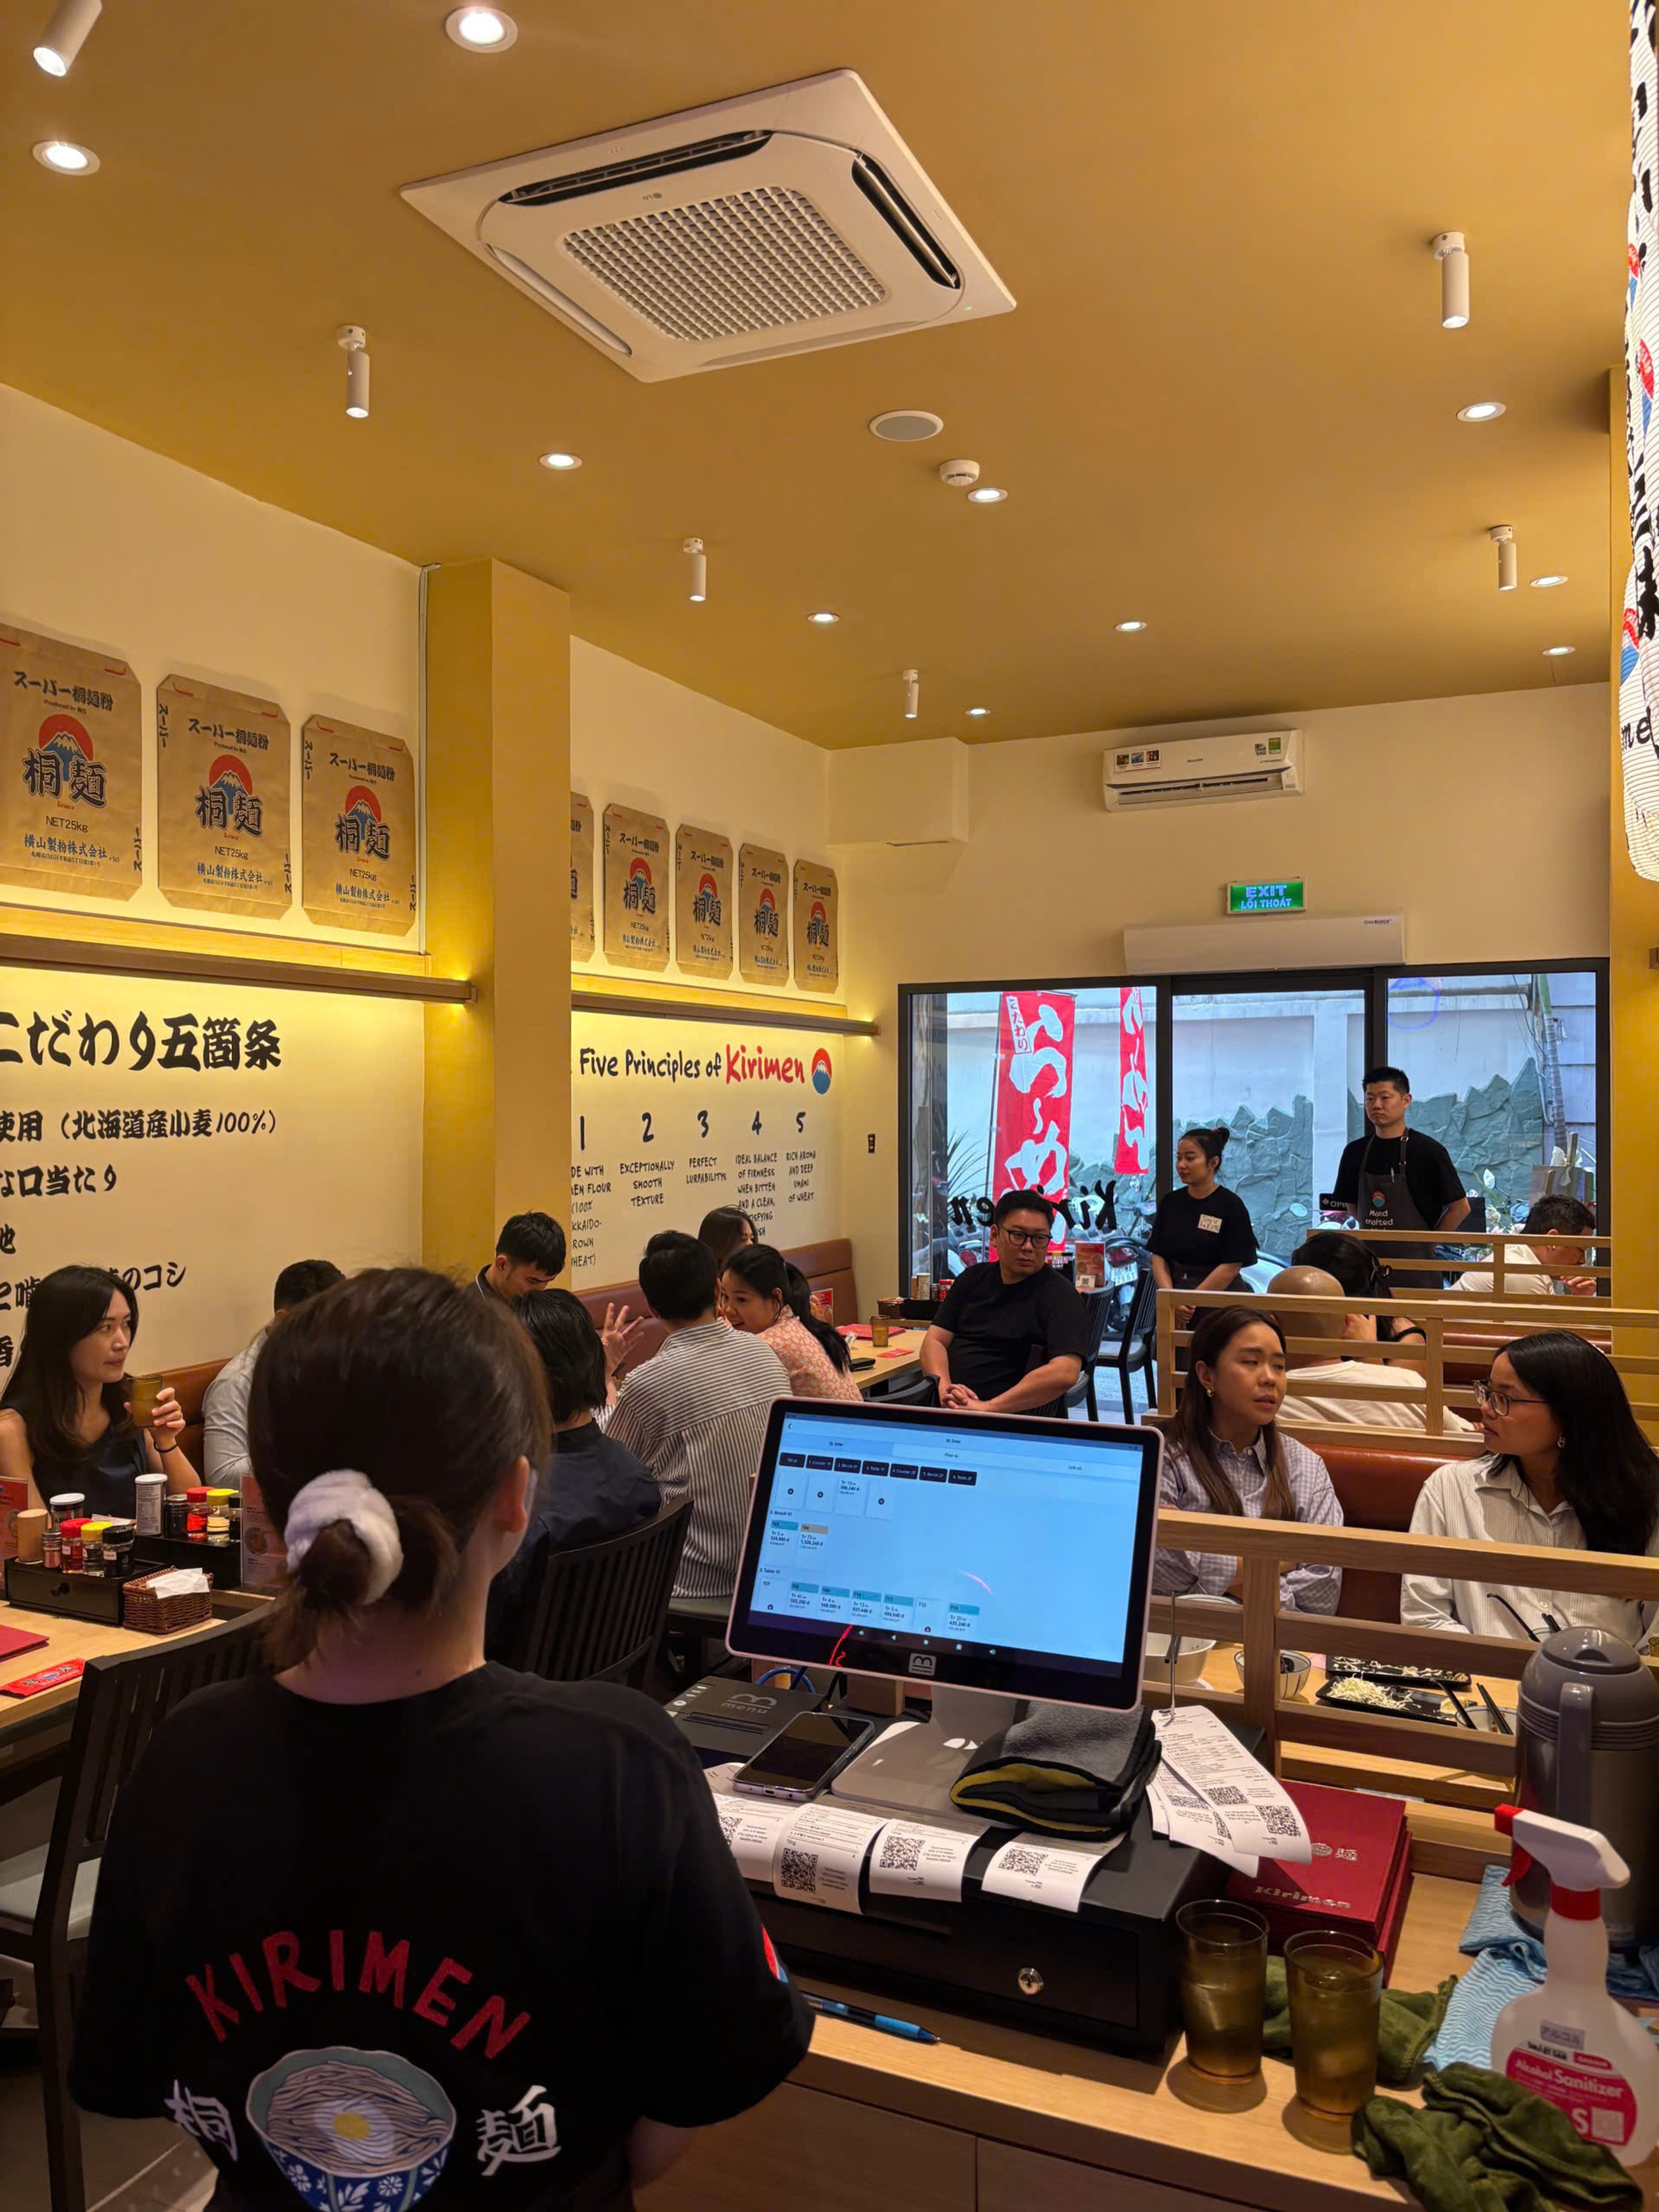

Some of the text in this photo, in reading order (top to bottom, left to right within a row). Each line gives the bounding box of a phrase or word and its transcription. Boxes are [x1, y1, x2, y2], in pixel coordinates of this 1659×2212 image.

[23, 748, 107, 808] 桐麺
[195, 786, 263, 838] 桐麺
[46, 816, 89, 833] NET25kg
[215, 845, 248, 860] NET25kg
[1246, 884, 1287, 898] EXIT
[1259, 896, 1292, 908] THOÁT
[579, 1044, 805, 1085] Five Principles of Kirimen
[580, 1110, 806, 1151] 1 2 3 4 5
[689, 1157, 718, 1168] PERFECT
[736, 1152, 778, 1164] IDEAL BALANCE
[786, 1150, 816, 1161] RICH AROMA
[585, 1165, 604, 1176] WITH
[620, 1160, 674, 1175] EXCEPTIONALLY
[738, 1168, 775, 1179] OF FIRMNESS
[789, 1163, 814, 1176] AND DEEP
[571, 1182, 611, 1196] EN FLOUR
[633, 1177, 662, 1189] SMOOTH
[737, 1182, 775, 1194] WHEN BITTEN
[630, 1193, 664, 1207] TEXTURE
[739, 1199, 749, 1209] AND
[751, 1198, 755, 1208] A
[788, 1192, 814, 1203] OF WHEAT
[721, 1702, 769, 1715] menu
[184, 1929, 531, 2059] KIRIMEN
[1515, 2059, 1553, 2080] Alcohol
[1555, 2069, 1624, 2098] Sanitizer
[1572, 2107, 1588, 2133] S
